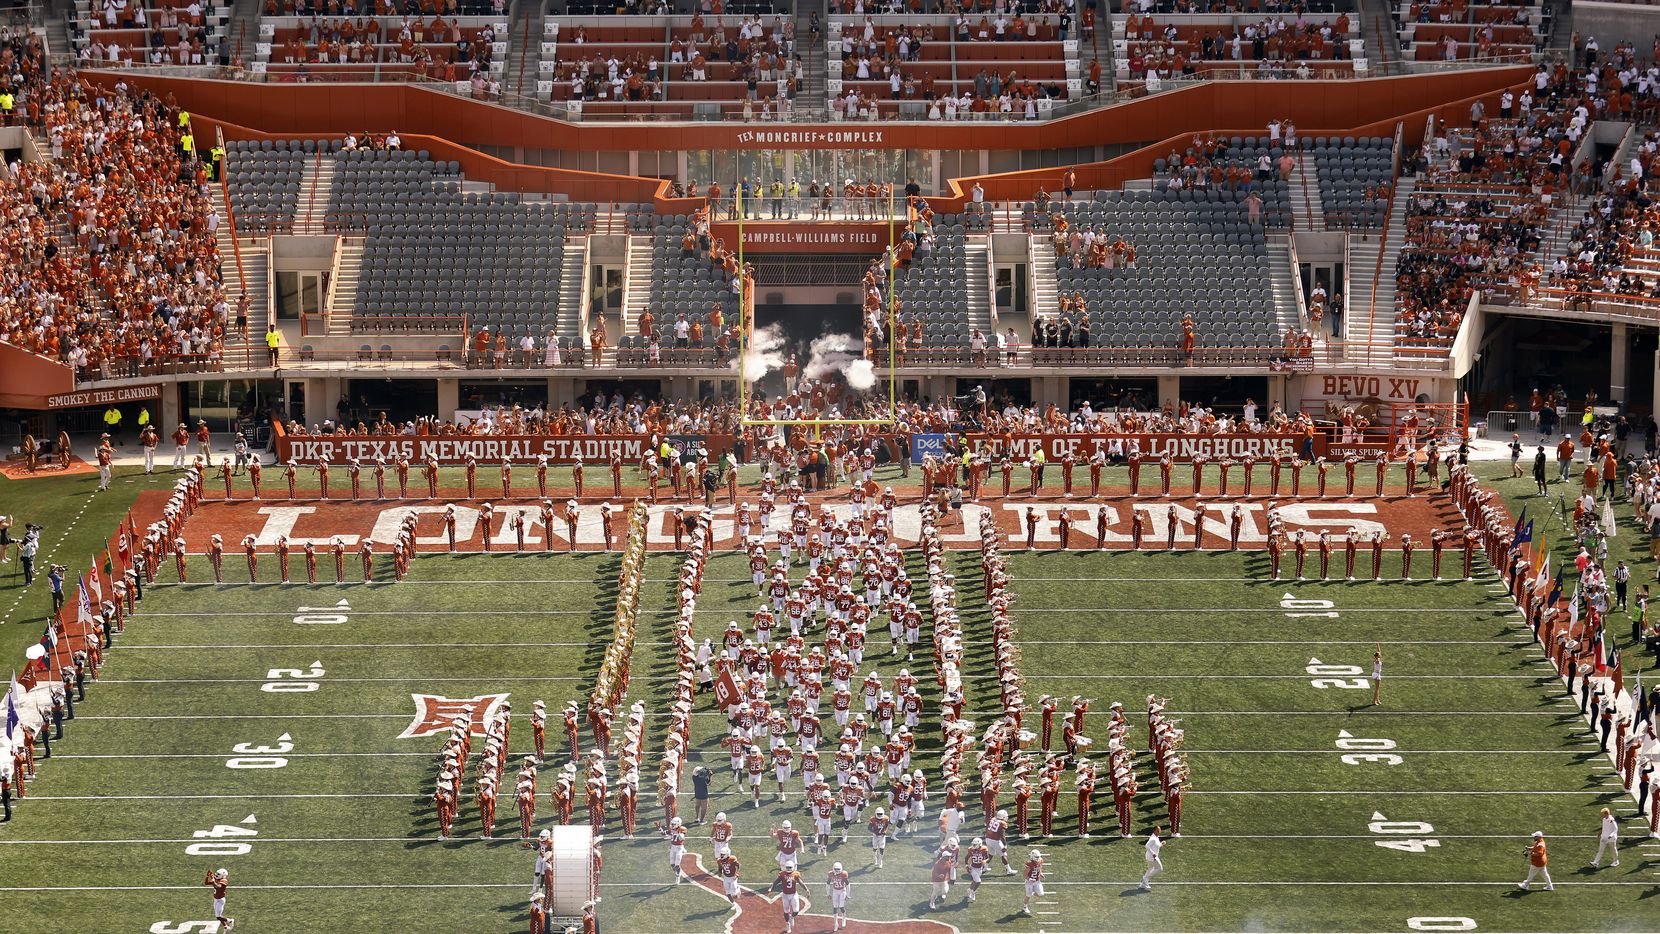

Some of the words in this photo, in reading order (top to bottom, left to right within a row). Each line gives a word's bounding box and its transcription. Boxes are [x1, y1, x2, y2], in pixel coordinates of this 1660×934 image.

[737, 130, 754, 144] TEX
[756, 132, 818, 143] MONCRIEF
[827, 132, 882, 142] COMPLEX
[741, 232, 845, 243] CAMPBELL-WILLIAMS
[850, 232, 877, 243] FIELD
[48, 392, 90, 408] SMOKEY
[94, 390, 116, 402] THE
[118, 386, 158, 400] CANNON
[1322, 375, 1380, 396] BEVO
[1388, 378, 1420, 400] XV
[290, 440, 413, 460] DKR-TEXAS
[420, 440, 536, 460] MEMORIAL
[543, 440, 642, 459] STADIUM
[917, 439, 946, 449] DEL
[1052, 439, 1082, 457] OF
[1150, 439, 1294, 458] LONGHORNS
